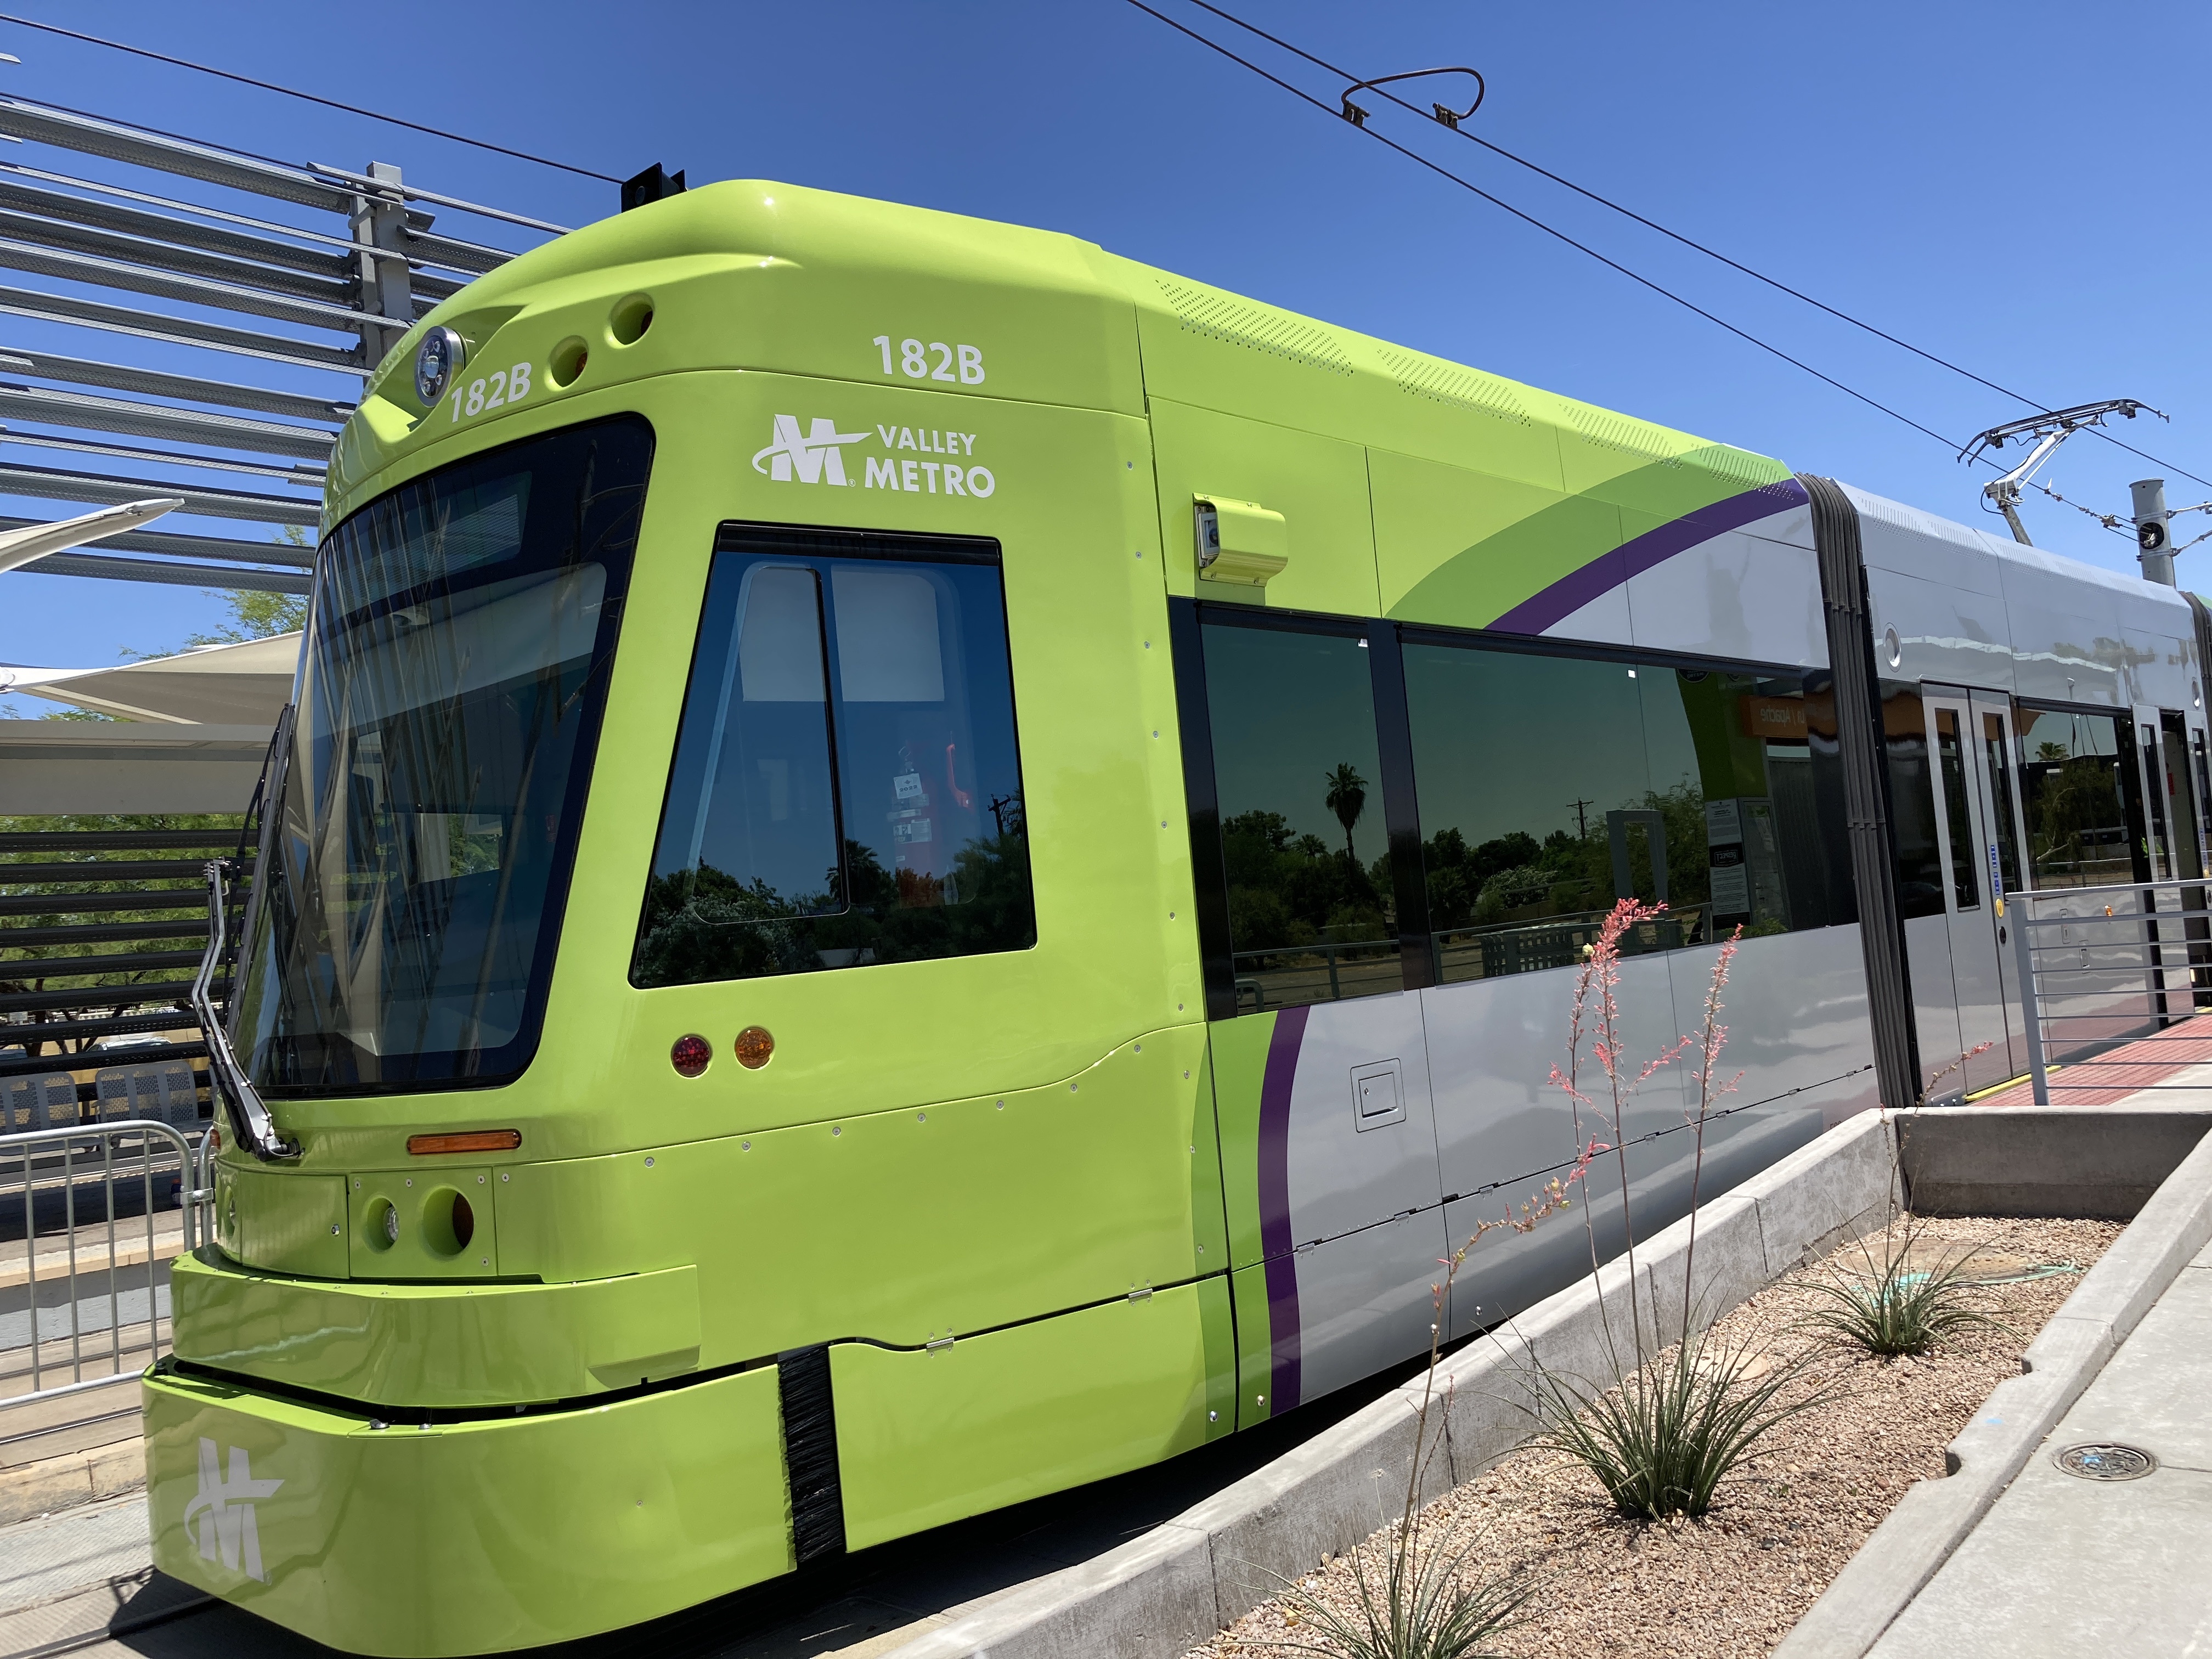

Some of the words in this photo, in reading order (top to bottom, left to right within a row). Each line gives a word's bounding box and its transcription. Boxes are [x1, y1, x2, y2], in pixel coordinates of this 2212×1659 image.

[873, 335, 985, 385] 182B
[451, 362, 532, 423] 182B
[876, 424, 977, 456] VALLEY
[865, 456, 995, 498] METRO
